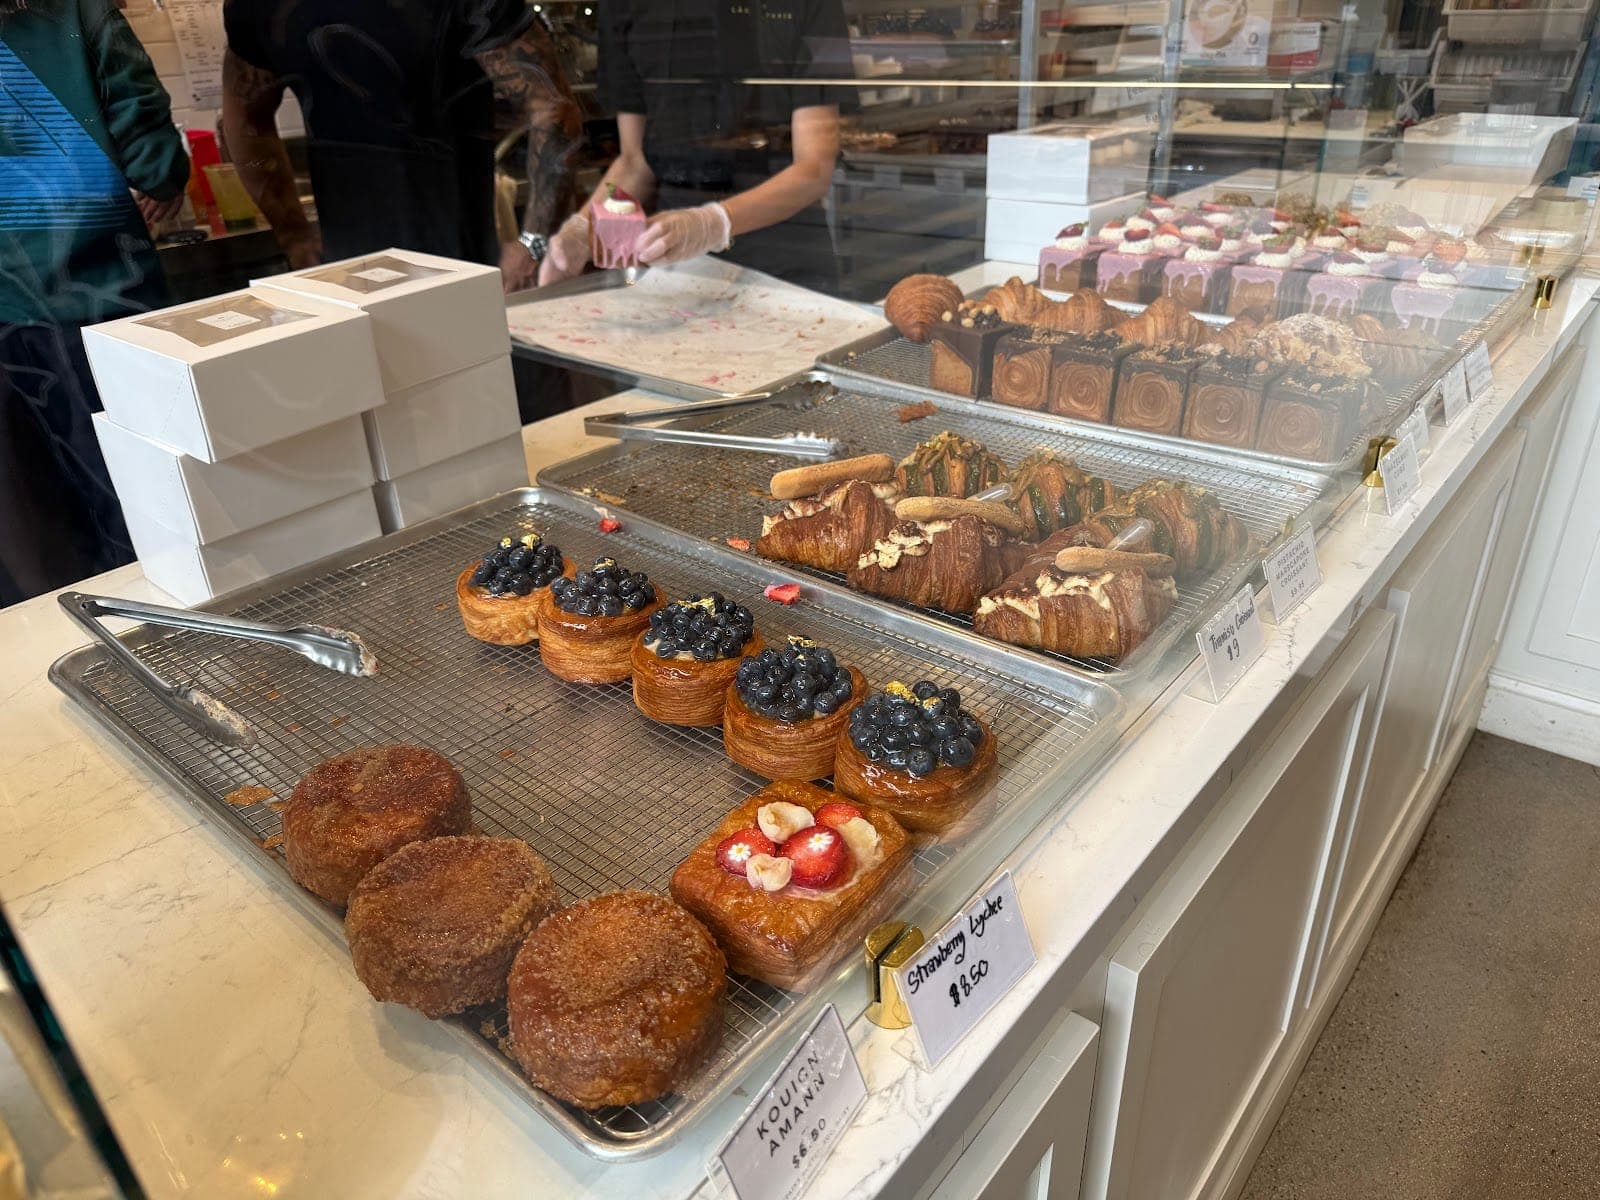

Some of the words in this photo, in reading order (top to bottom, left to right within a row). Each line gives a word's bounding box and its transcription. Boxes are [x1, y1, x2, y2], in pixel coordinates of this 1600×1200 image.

[1280, 557, 1309, 588] CROISSANT
[907, 929, 966, 995] Strawberry
[968, 895, 1003, 938] Lychee
[949, 960, 989, 1008] $8.50
[756, 1050, 820, 1140] KOUIGN
[769, 1071, 826, 1158] AMANN
